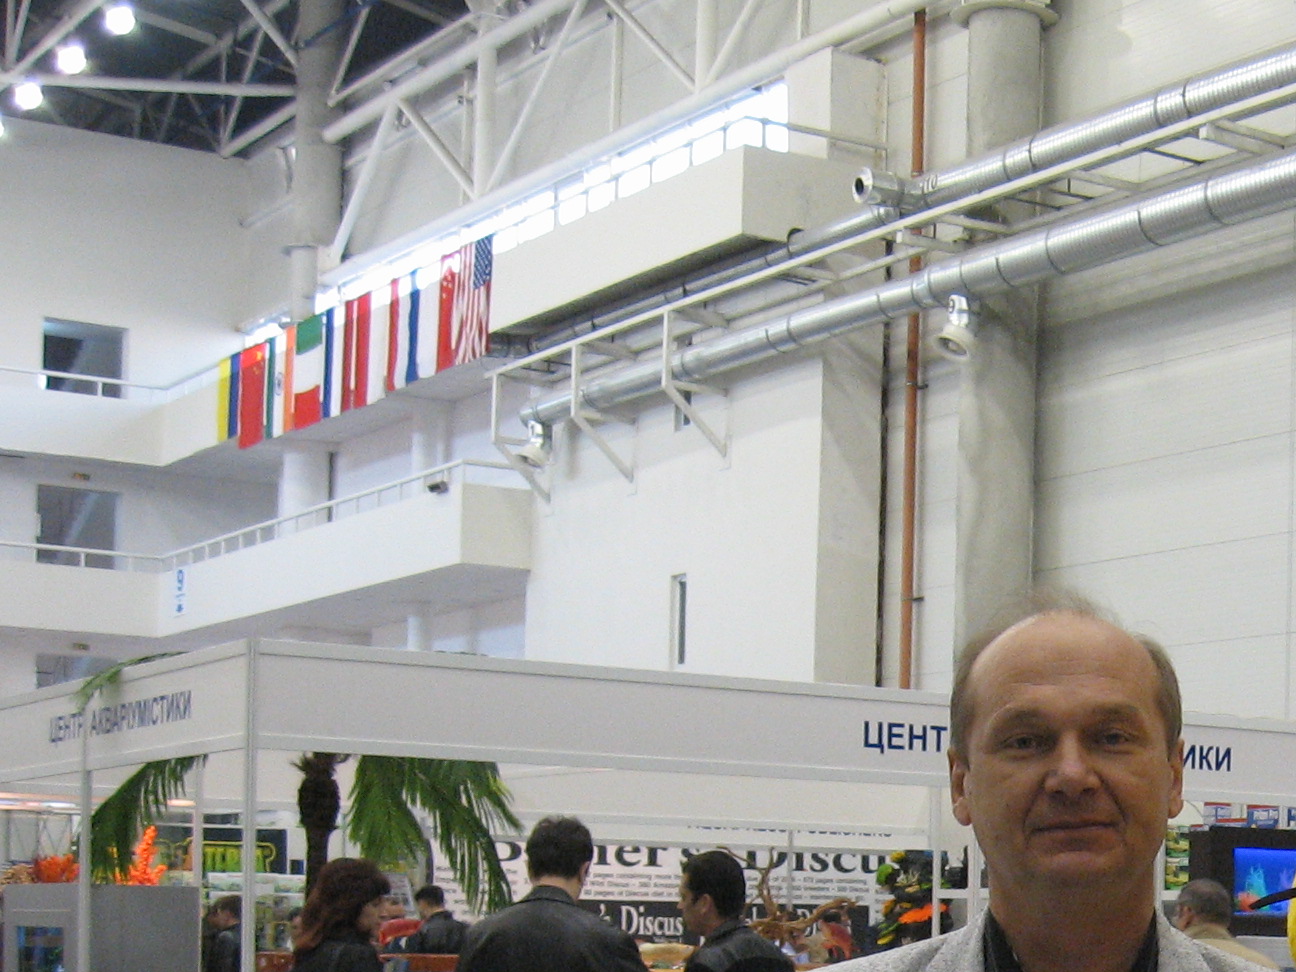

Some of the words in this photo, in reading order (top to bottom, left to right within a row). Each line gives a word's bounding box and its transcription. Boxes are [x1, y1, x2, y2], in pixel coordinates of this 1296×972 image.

[49, 712, 84, 747] ЦЕНТР
[863, 720, 948, 754] ЦЕНТ
[742, 850, 895, 874] Discu
[620, 904, 683, 936] Discus
